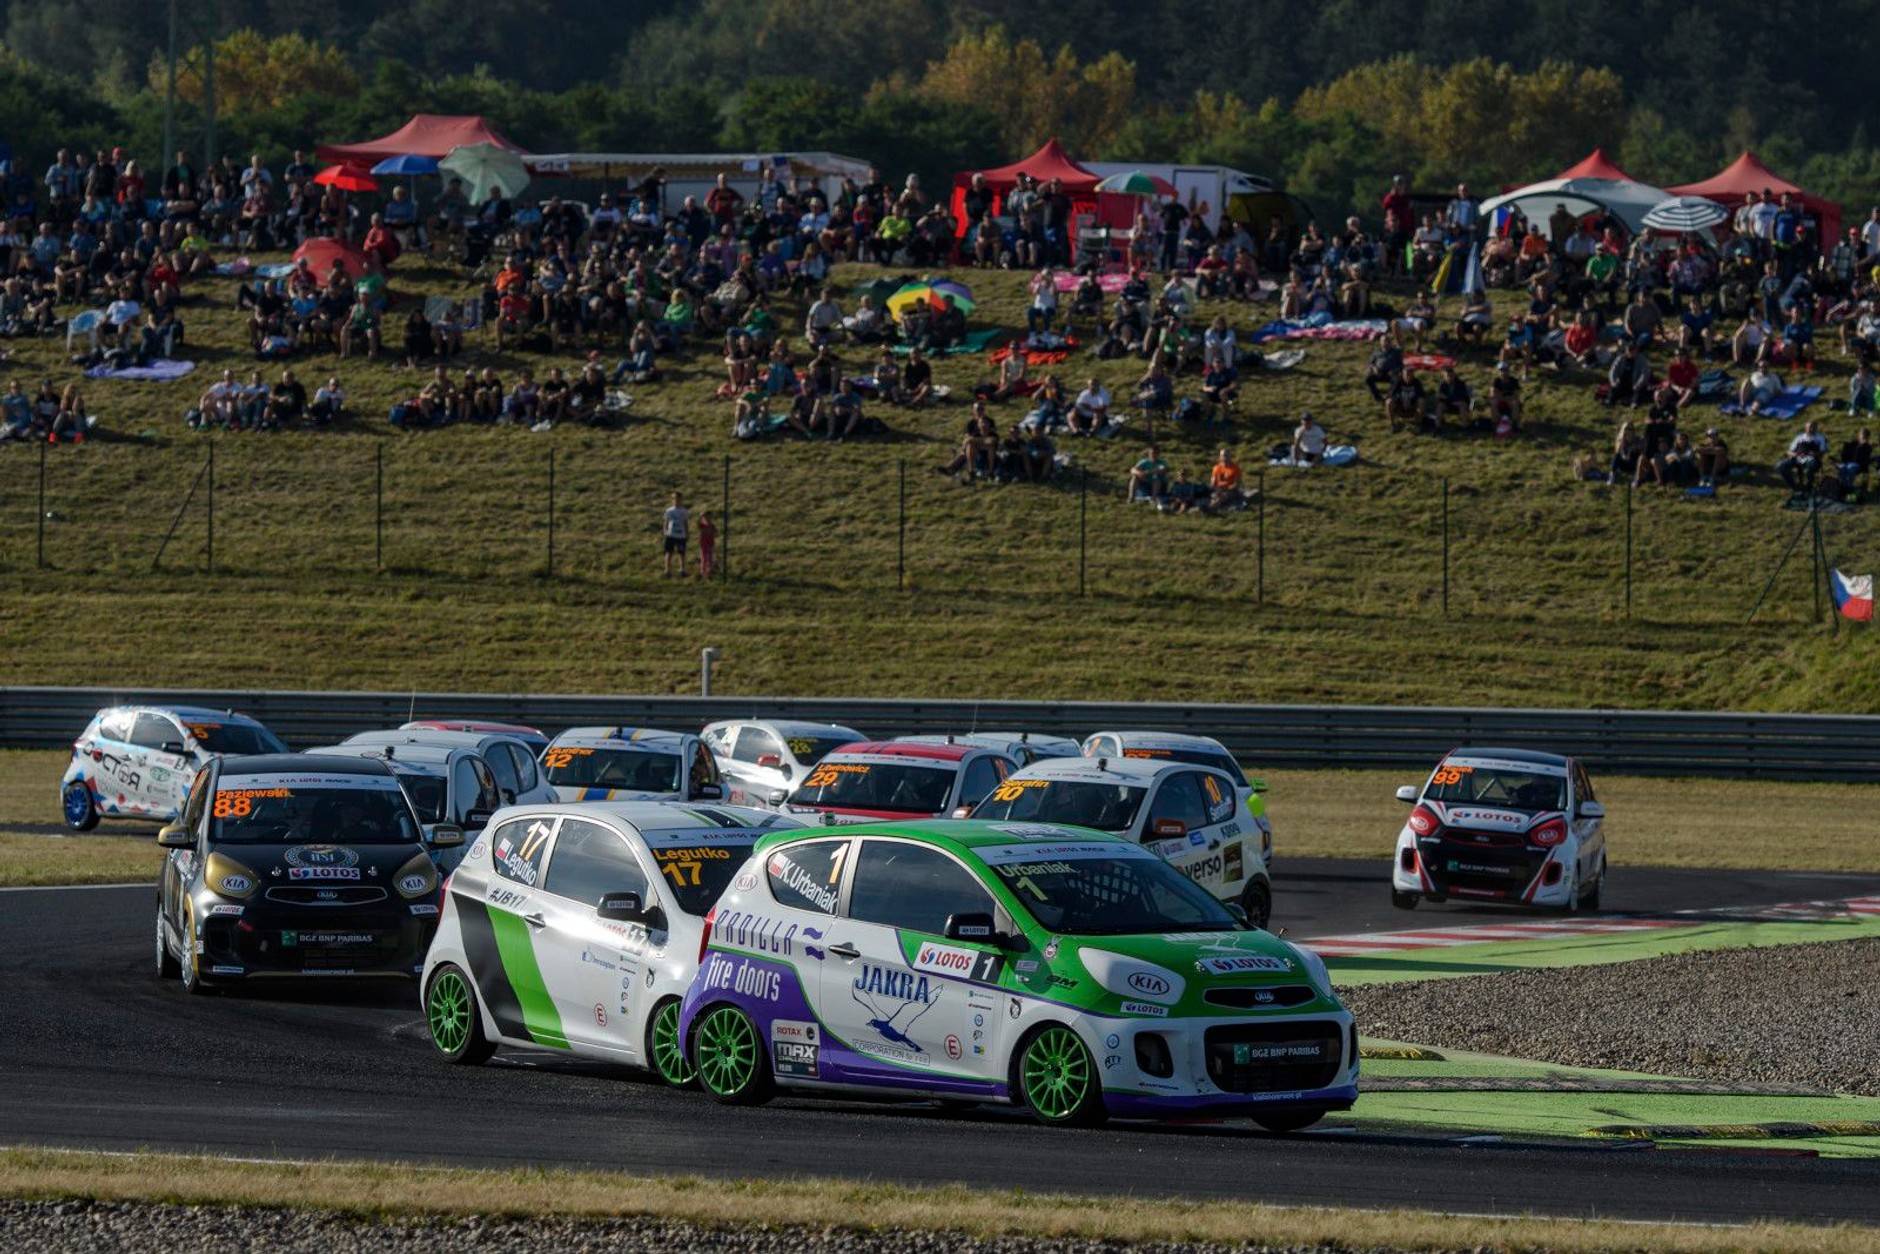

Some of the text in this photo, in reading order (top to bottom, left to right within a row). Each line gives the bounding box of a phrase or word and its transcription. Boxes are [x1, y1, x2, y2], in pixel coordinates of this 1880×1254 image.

[546, 754, 573, 768] 12
[804, 771, 838, 787] 29
[1433, 771, 1461, 786] 99
[993, 787, 1025, 801] 10
[213, 798, 252, 818] 88
[1475, 812, 1521, 823] LOTOS
[520, 821, 550, 861] 17
[653, 847, 731, 862] Legutko
[504, 845, 536, 885] Legutko
[829, 843, 851, 884] 1
[997, 861, 1074, 877] Urbaniak
[313, 869, 359, 878] LOTOS
[662, 862, 702, 887] 17
[222, 878, 245, 888] KIA
[406, 878, 423, 889] KIA
[738, 876, 755, 888] KIA
[780, 859, 838, 914] K.Urbaniak
[1016, 876, 1049, 901] 1
[488, 887, 527, 909] #JB17
[319, 934, 336, 942] BNP
[337, 934, 373, 943] PARIBAS
[934, 950, 972, 970] LOTOS
[1231, 958, 1280, 969] LOTOS
[982, 957, 995, 980] 1
[704, 952, 781, 1002] fire doors
[855, 965, 930, 1003] JAKRA
[1135, 976, 1161, 992] KIA
[1256, 992, 1274, 1001] KIA
[1136, 1006, 1164, 1015] LOTOS
[777, 1027, 801, 1036] ROTAX
[1271, 1047, 1286, 1057] BNP
[1288, 1046, 1320, 1056] PARIBAS
